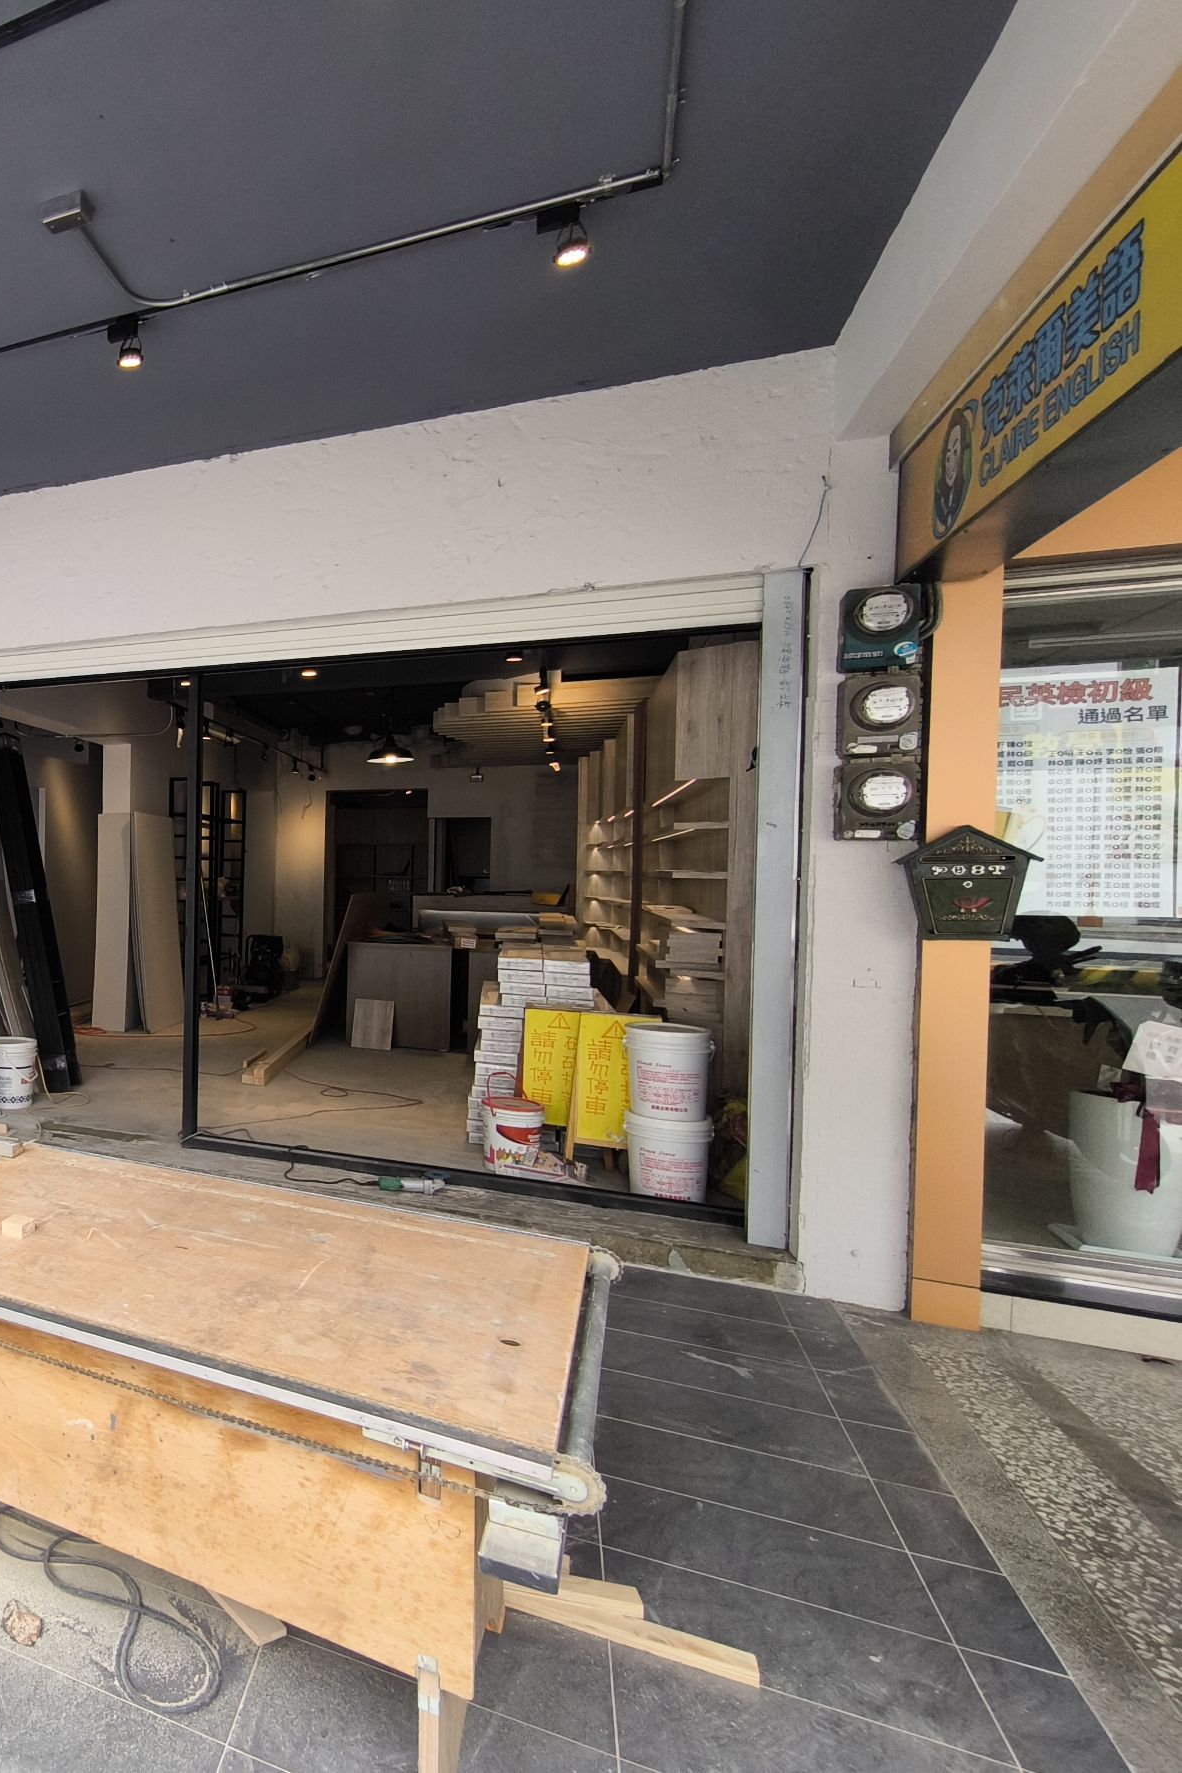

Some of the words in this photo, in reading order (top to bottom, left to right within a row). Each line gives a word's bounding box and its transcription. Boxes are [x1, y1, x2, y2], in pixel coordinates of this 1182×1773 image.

[980, 218, 1144, 450] 克萊爾美語
[979, 404, 1040, 488] CLAIRE
[1043, 310, 1141, 433] ENGLISH
[1077, 704, 1169, 725] 通過名單
[931, 864, 1007, 876] POST
[530, 1029, 557, 1108] 請勿停車
[585, 1039, 613, 1116] 請勿停車
